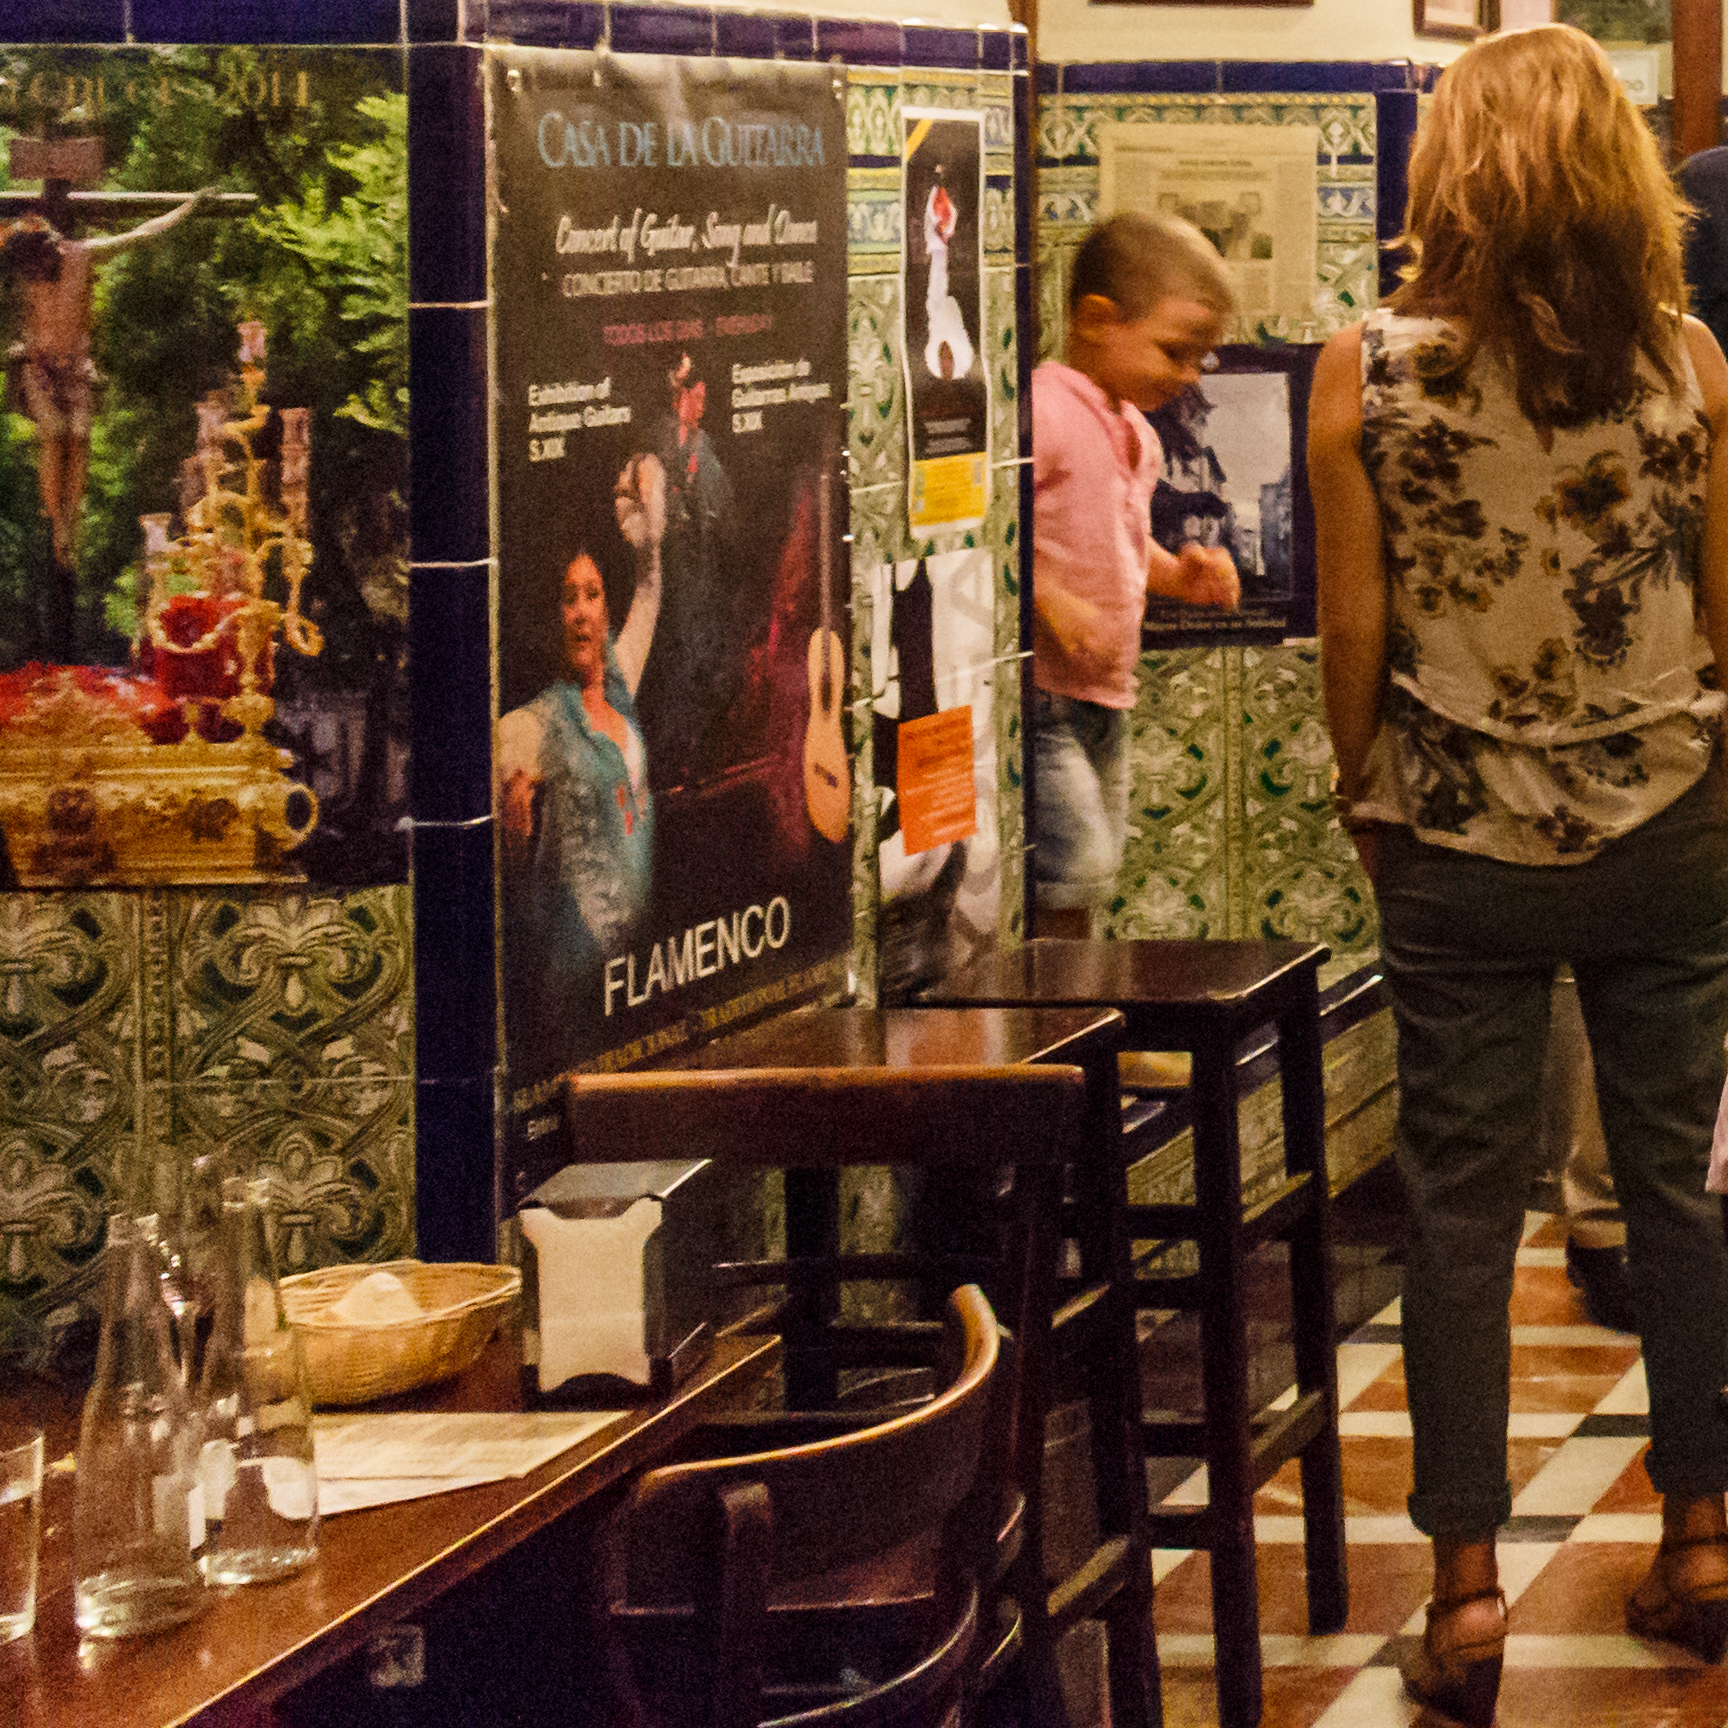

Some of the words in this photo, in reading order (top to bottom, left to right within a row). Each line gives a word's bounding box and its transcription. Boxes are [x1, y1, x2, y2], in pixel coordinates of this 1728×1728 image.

[537, 110, 611, 169] CASA
[618, 120, 657, 168] DE
[667, 120, 695, 168] LA
[702, 115, 826, 169] GUITARRA
[620, 207, 643, 264] of
[643, 268, 664, 293] DE
[604, 895, 791, 1018] FLAMENCO
